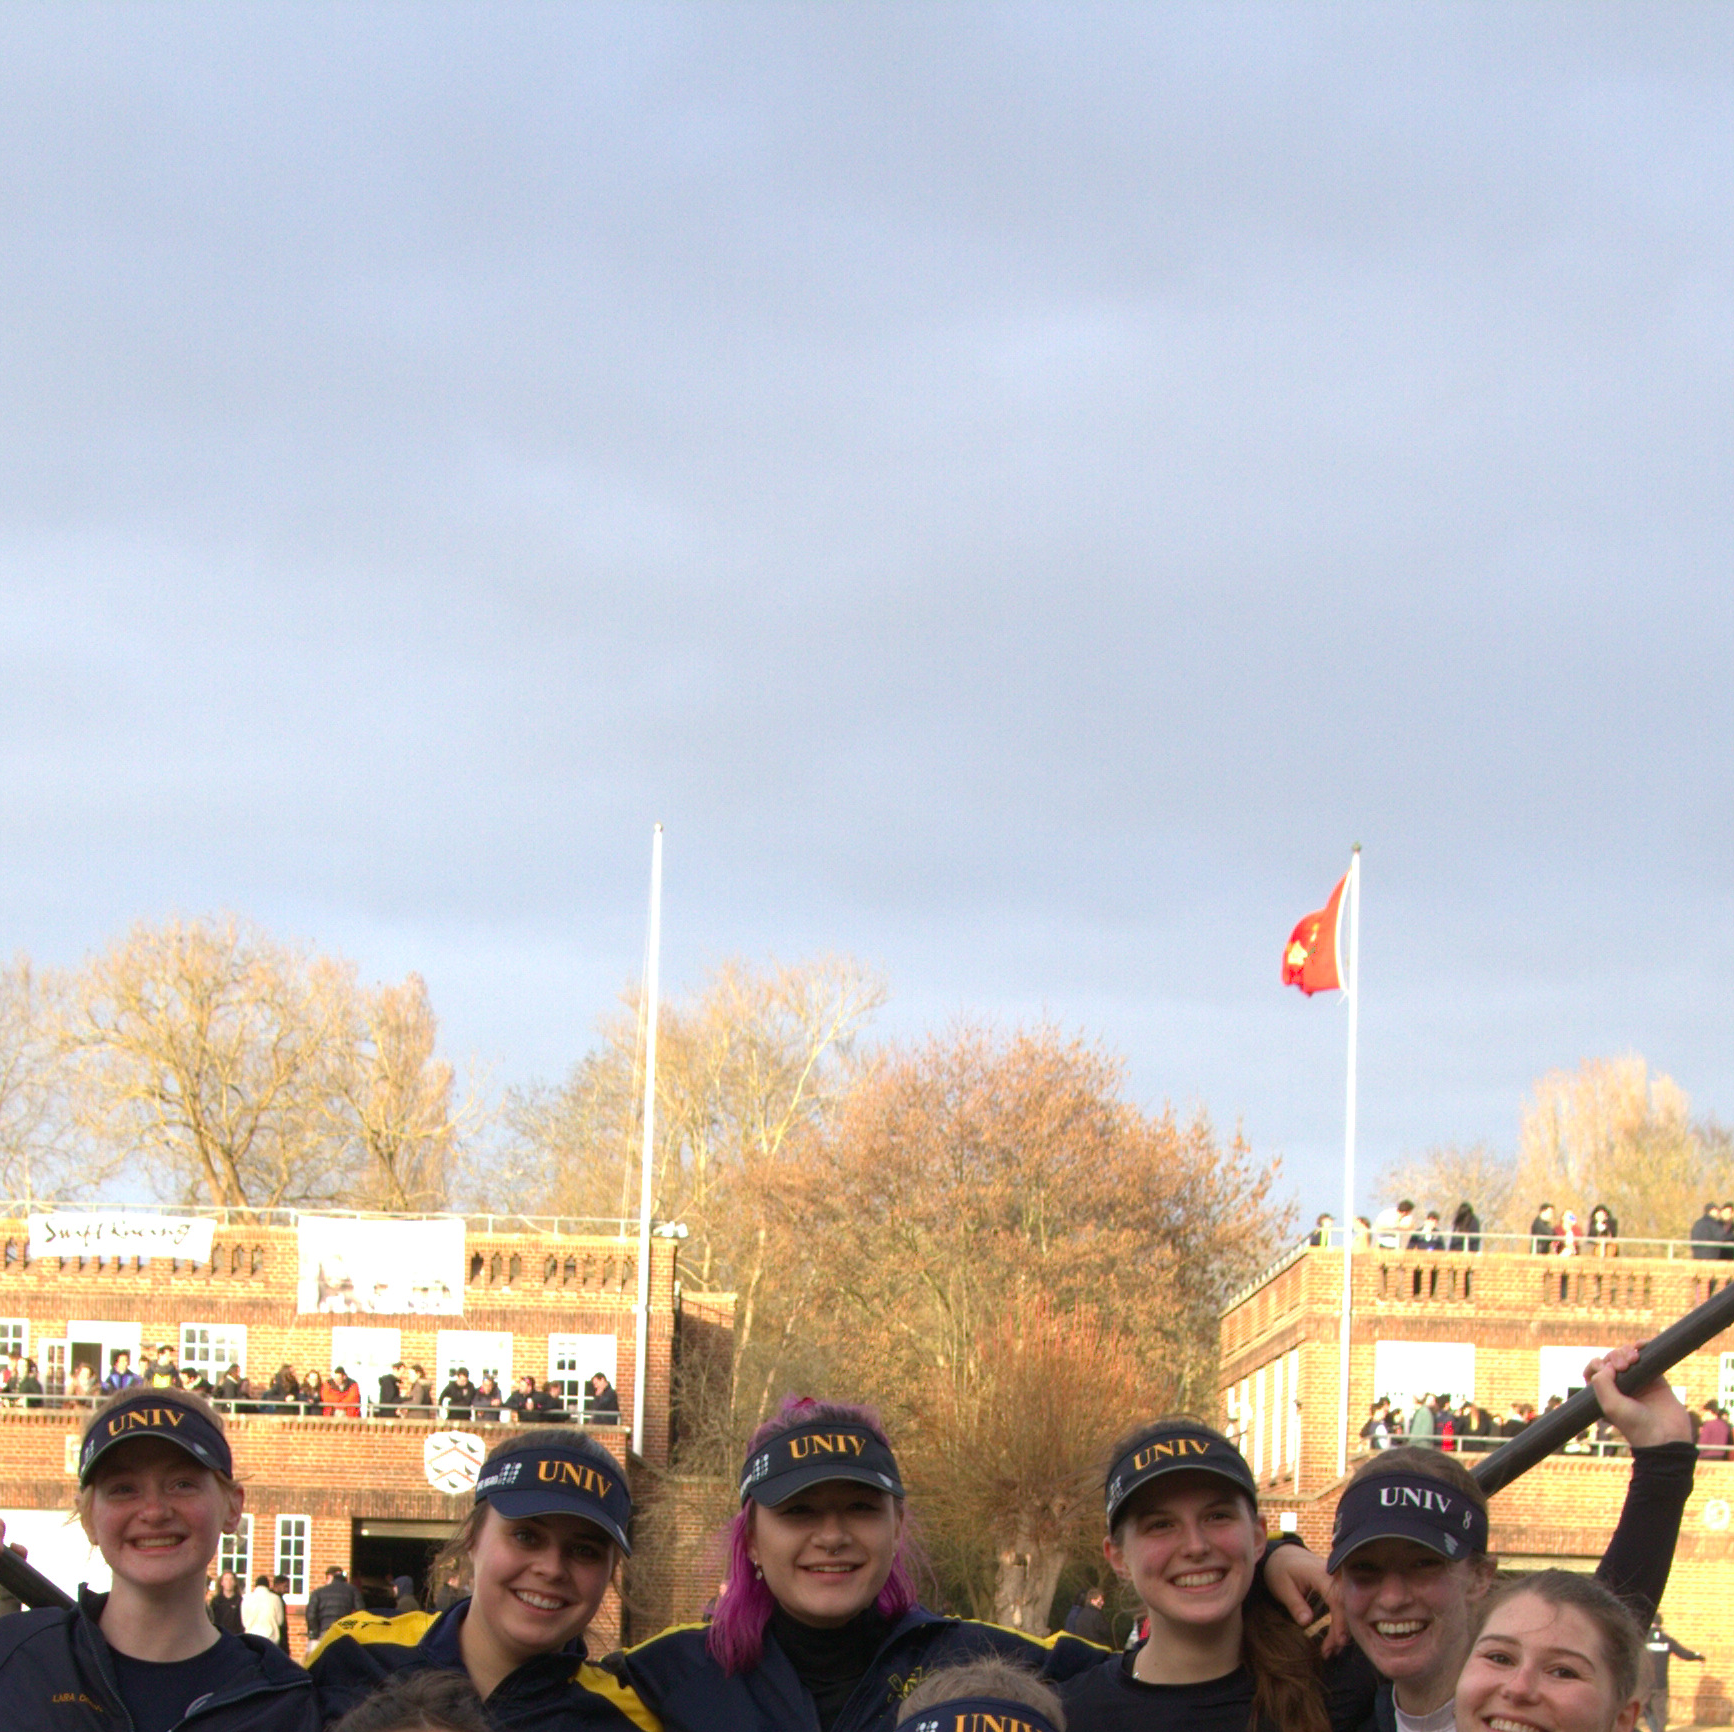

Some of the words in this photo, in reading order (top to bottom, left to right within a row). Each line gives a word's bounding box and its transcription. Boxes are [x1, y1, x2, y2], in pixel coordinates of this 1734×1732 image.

[108, 1408, 185, 1437] UNIV
[788, 1433, 866, 1460] UNIV
[1133, 1438, 1210, 1471] UNIV
[537, 1460, 613, 1499] UNIV
[1379, 1486, 1452, 1514] UNIV
[1462, 1510, 1473, 1530] 8
